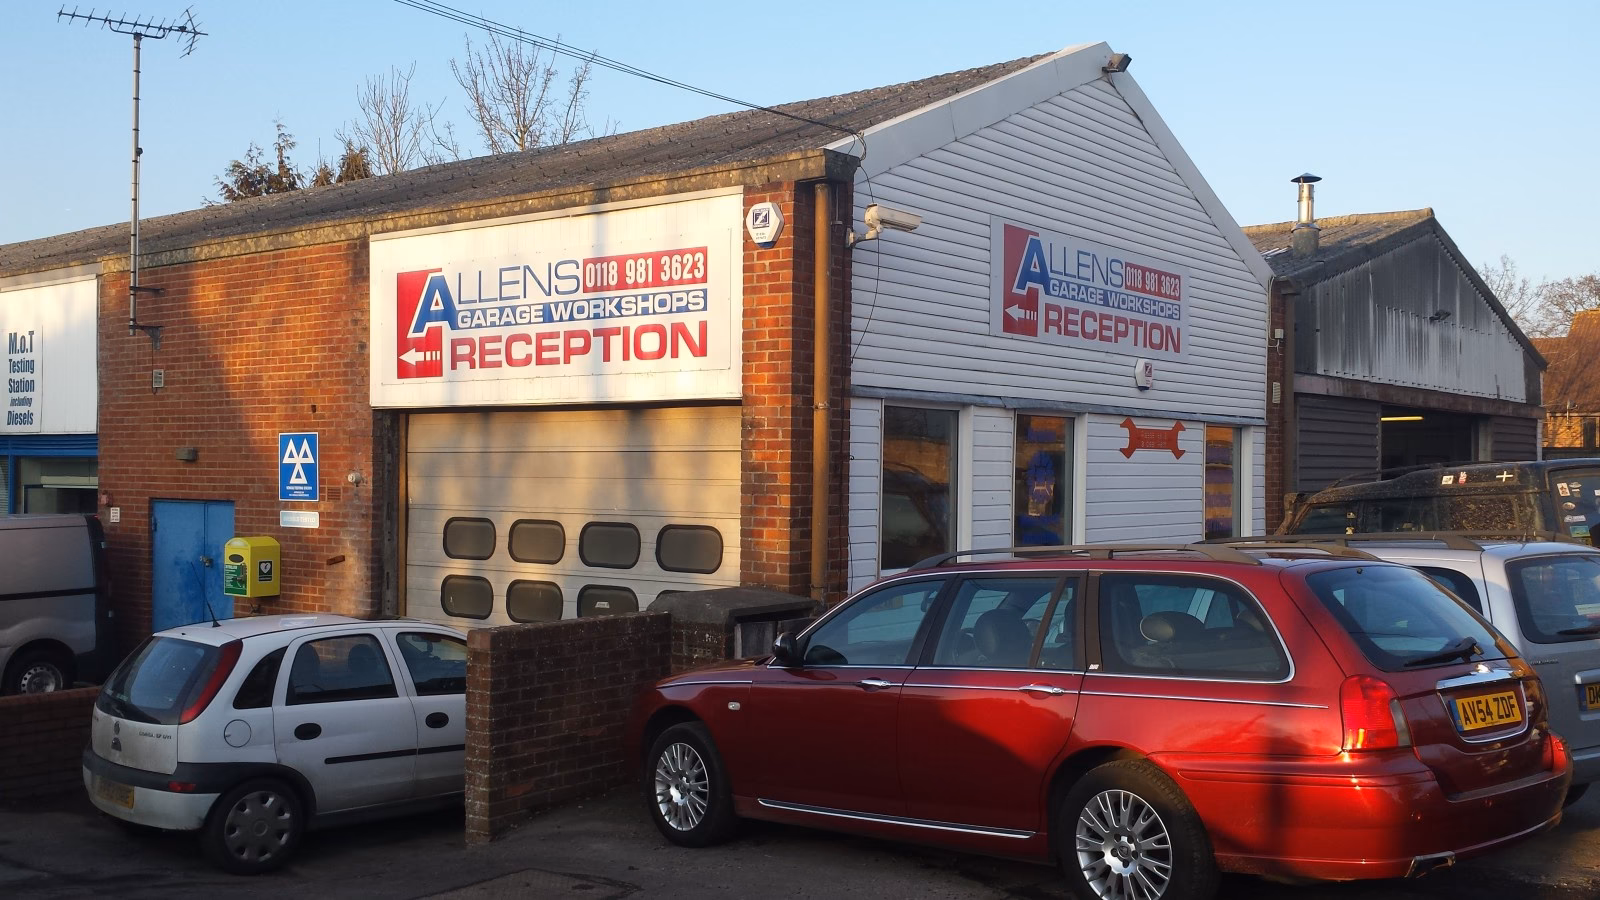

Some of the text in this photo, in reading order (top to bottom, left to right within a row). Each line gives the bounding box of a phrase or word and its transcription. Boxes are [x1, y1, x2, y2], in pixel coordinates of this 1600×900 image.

[585, 252, 705, 287] 0118 981 3623
[1015, 237, 1124, 295] ALLENS
[1126, 266, 1180, 297] 0118 981 3623
[411, 260, 581, 334] ALLENS
[456, 289, 705, 328] GARAGE WORKSHOPS
[1049, 279, 1180, 318] GARAGE WORKSHOPS
[8, 330, 35, 355] M.o.T
[1044, 302, 1181, 354] RECEPTION
[450, 320, 708, 371] RECEPTION
[8, 358, 35, 374] Testing
[8, 377, 35, 394] Station
[9, 396, 33, 408] including
[6, 410, 34, 426] Diesels
[1461, 695, 1515, 725] AV54 ZDF
